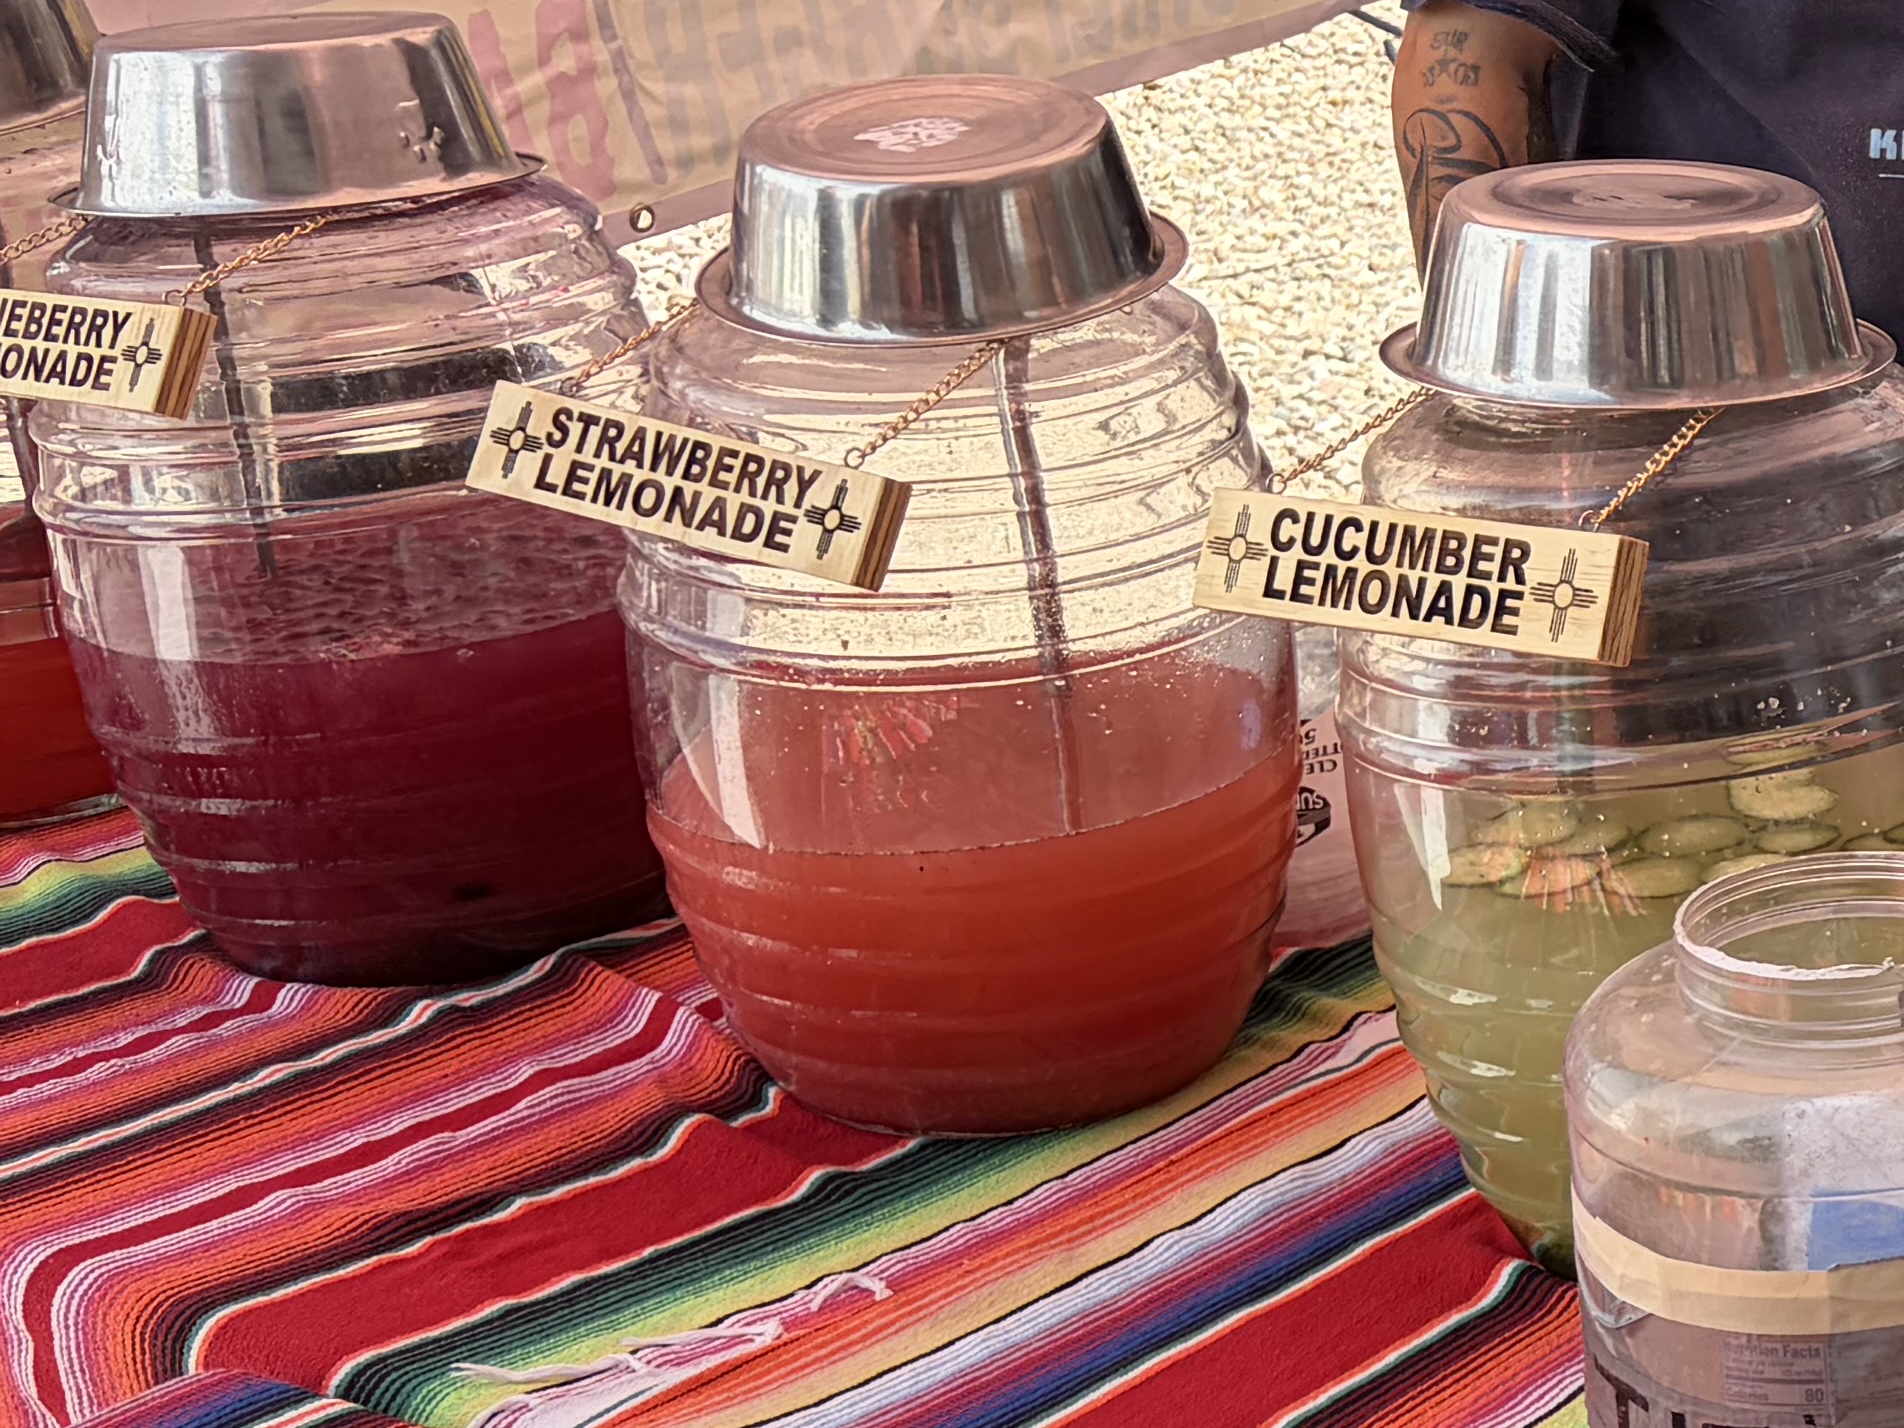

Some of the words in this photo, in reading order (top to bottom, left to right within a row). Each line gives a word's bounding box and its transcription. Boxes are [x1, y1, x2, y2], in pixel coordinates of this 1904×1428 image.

[0, 342, 119, 392] ONADE
[544, 405, 823, 511] STRAWBERRY
[531, 449, 801, 555] LEMONADE
[1268, 505, 1533, 587] CUCUMBER
[1261, 560, 1525, 637] LEMONADE
[1782, 1343, 1822, 1361] Facts
[1803, 1387, 1826, 1404] 80
